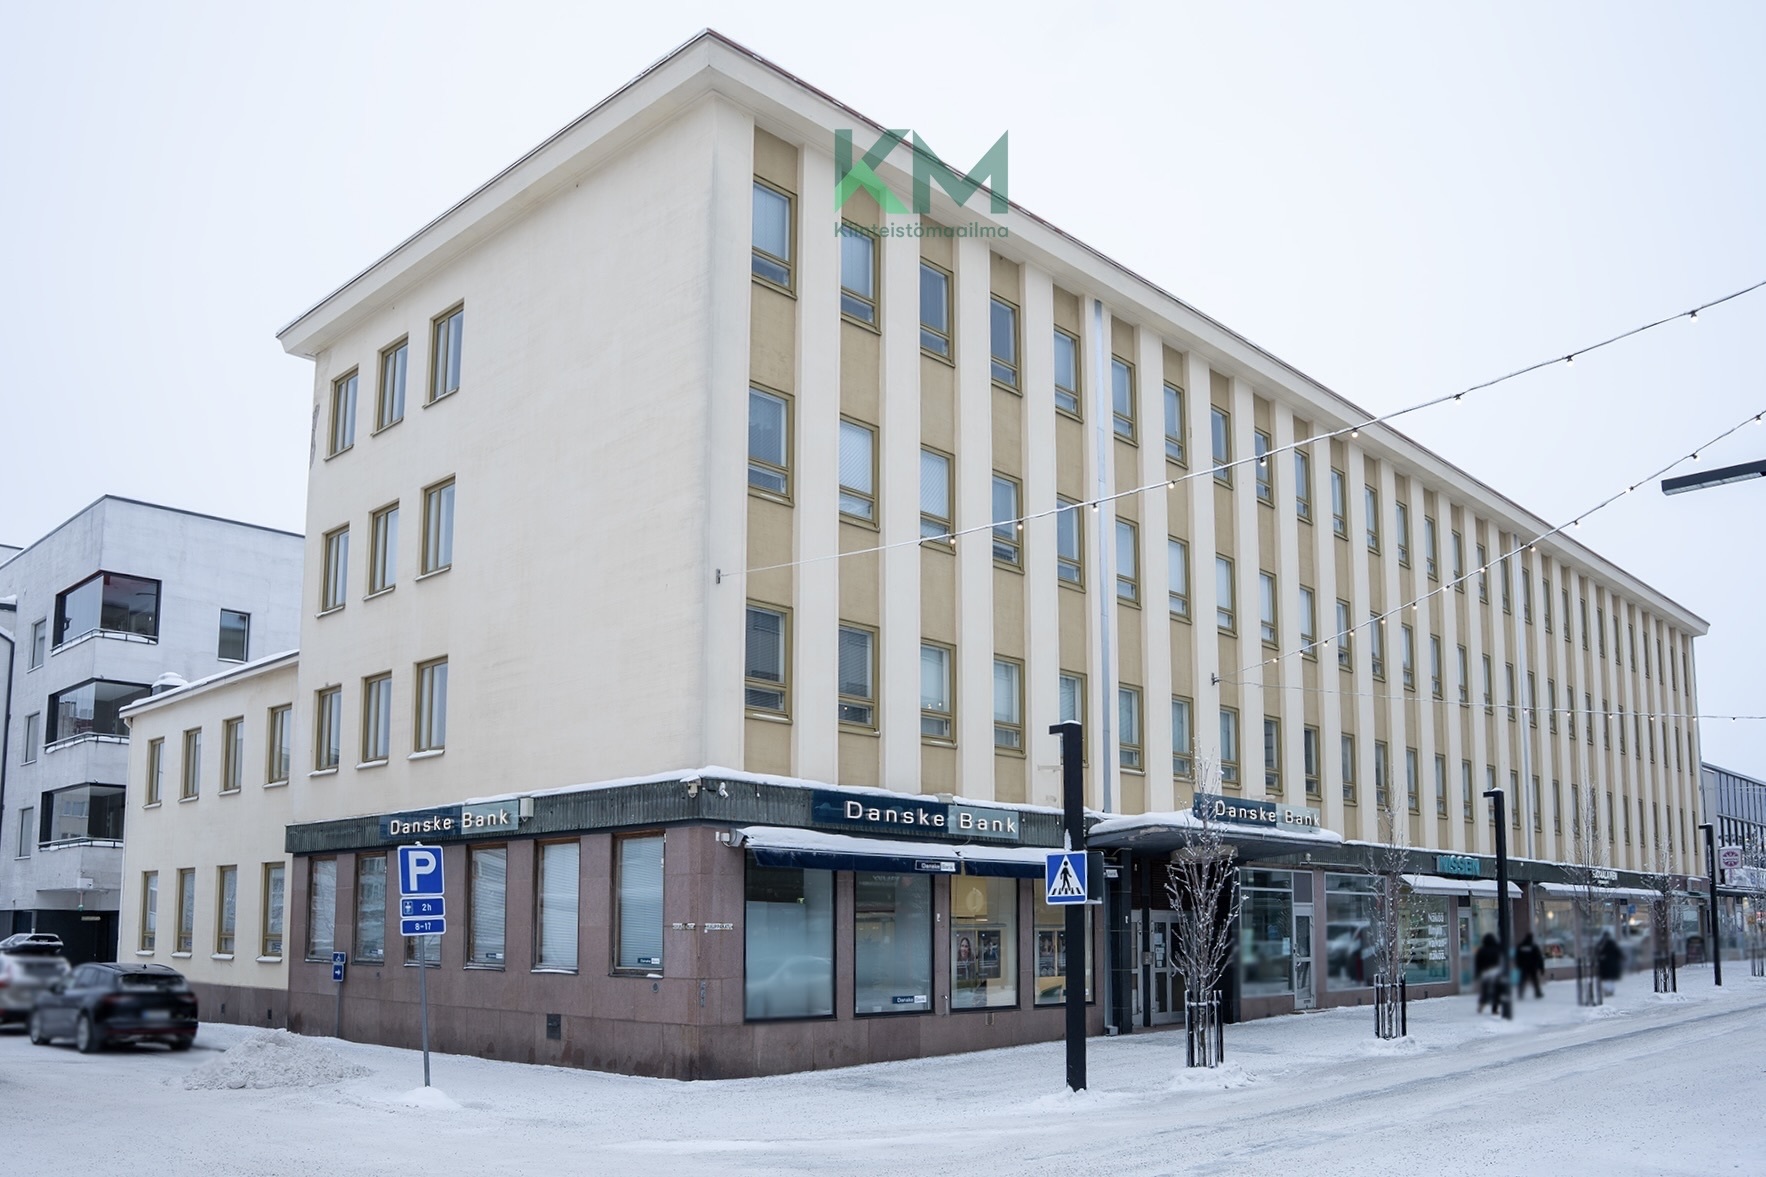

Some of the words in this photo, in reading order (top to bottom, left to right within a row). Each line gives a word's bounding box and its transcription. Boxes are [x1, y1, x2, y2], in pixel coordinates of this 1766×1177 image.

[390, 816, 452, 835] Danske
[462, 809, 508, 828] Bank
[844, 800, 945, 827] Danske
[960, 813, 1016, 833] Bank
[1215, 800, 1276, 822] Danske
[1285, 810, 1320, 826] Bank
[408, 851, 436, 891] P
[421, 903, 432, 911] 2h
[415, 922, 431, 931] 8-17
